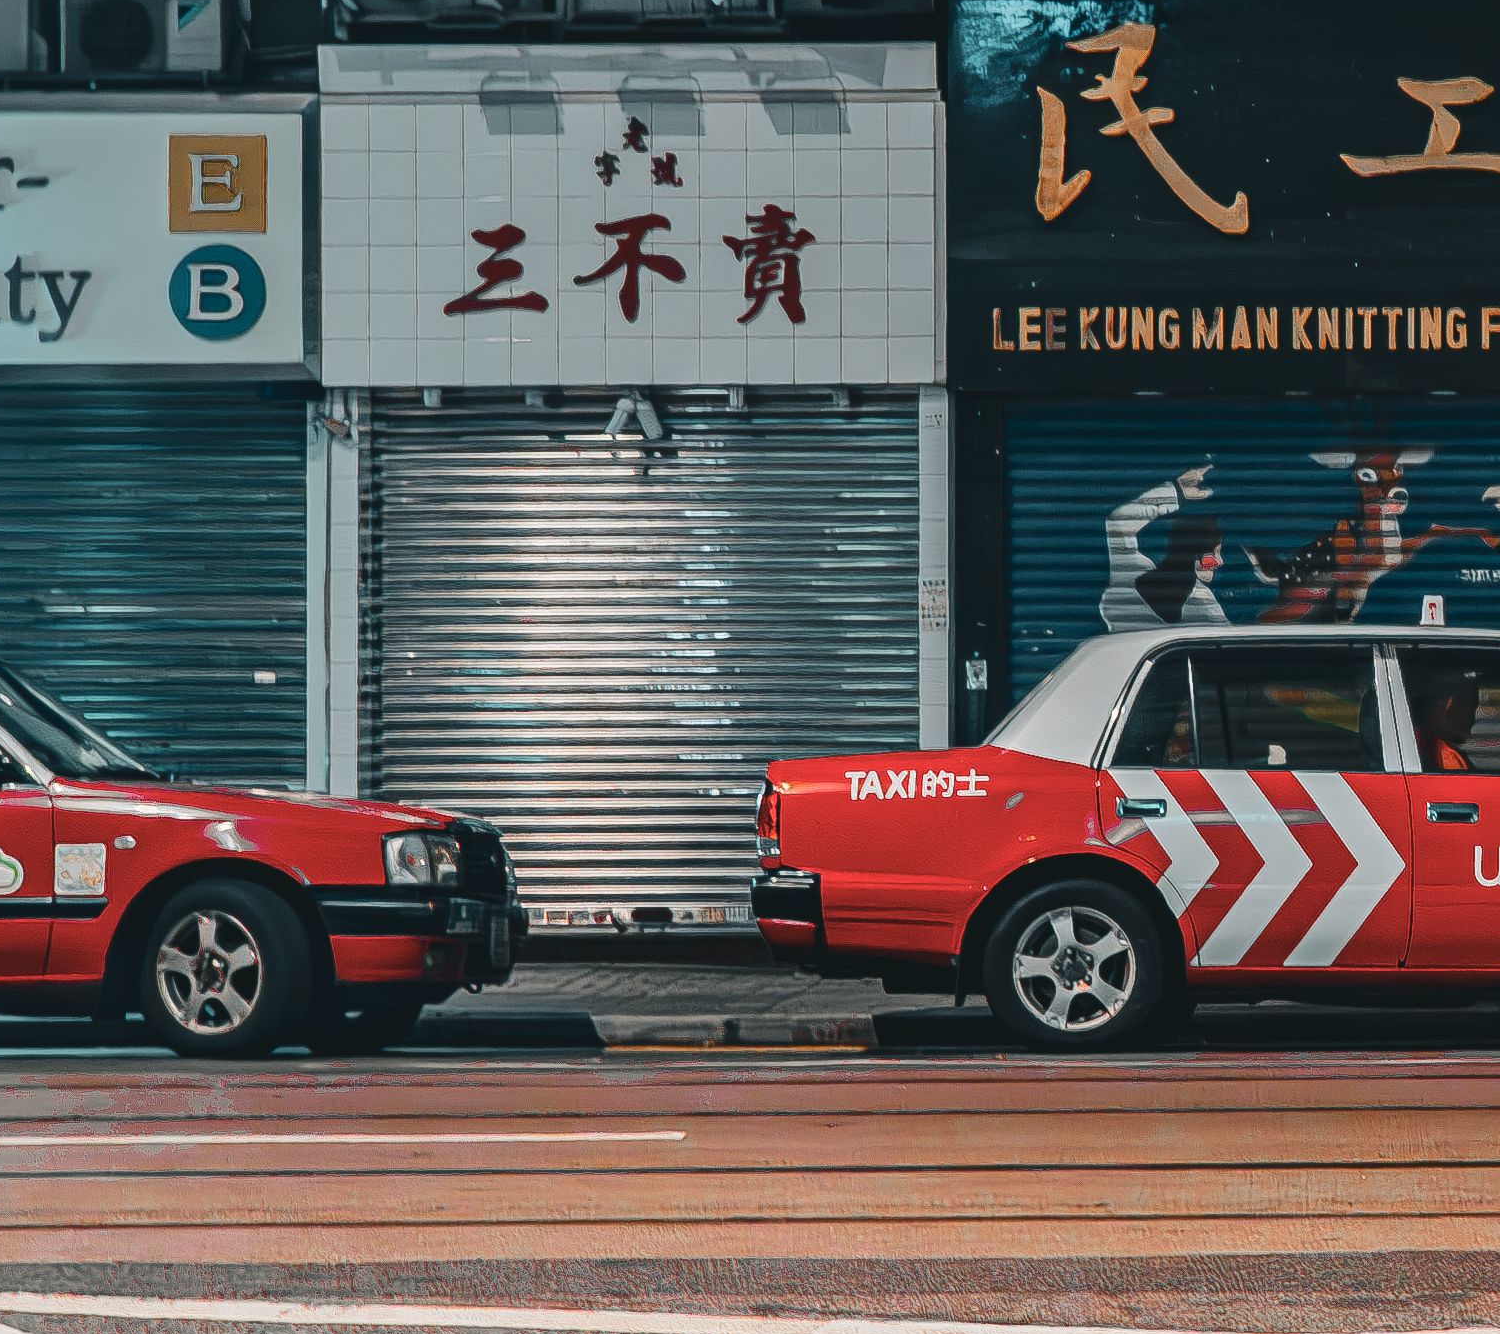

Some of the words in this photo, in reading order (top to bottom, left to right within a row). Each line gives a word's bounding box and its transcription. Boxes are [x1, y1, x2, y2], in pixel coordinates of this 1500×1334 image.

[188, 153, 241, 212] E
[187, 264, 243, 320] B
[443, 204, 816, 324] 三不賣
[993, 307, 1066, 350] LEE
[1080, 307, 1180, 350] KUNG
[1192, 306, 1279, 350] MAN
[1292, 307, 1468, 350] KNITTING
[846, 770, 916, 800] TAXI
[922, 769, 990, 798] 的士
